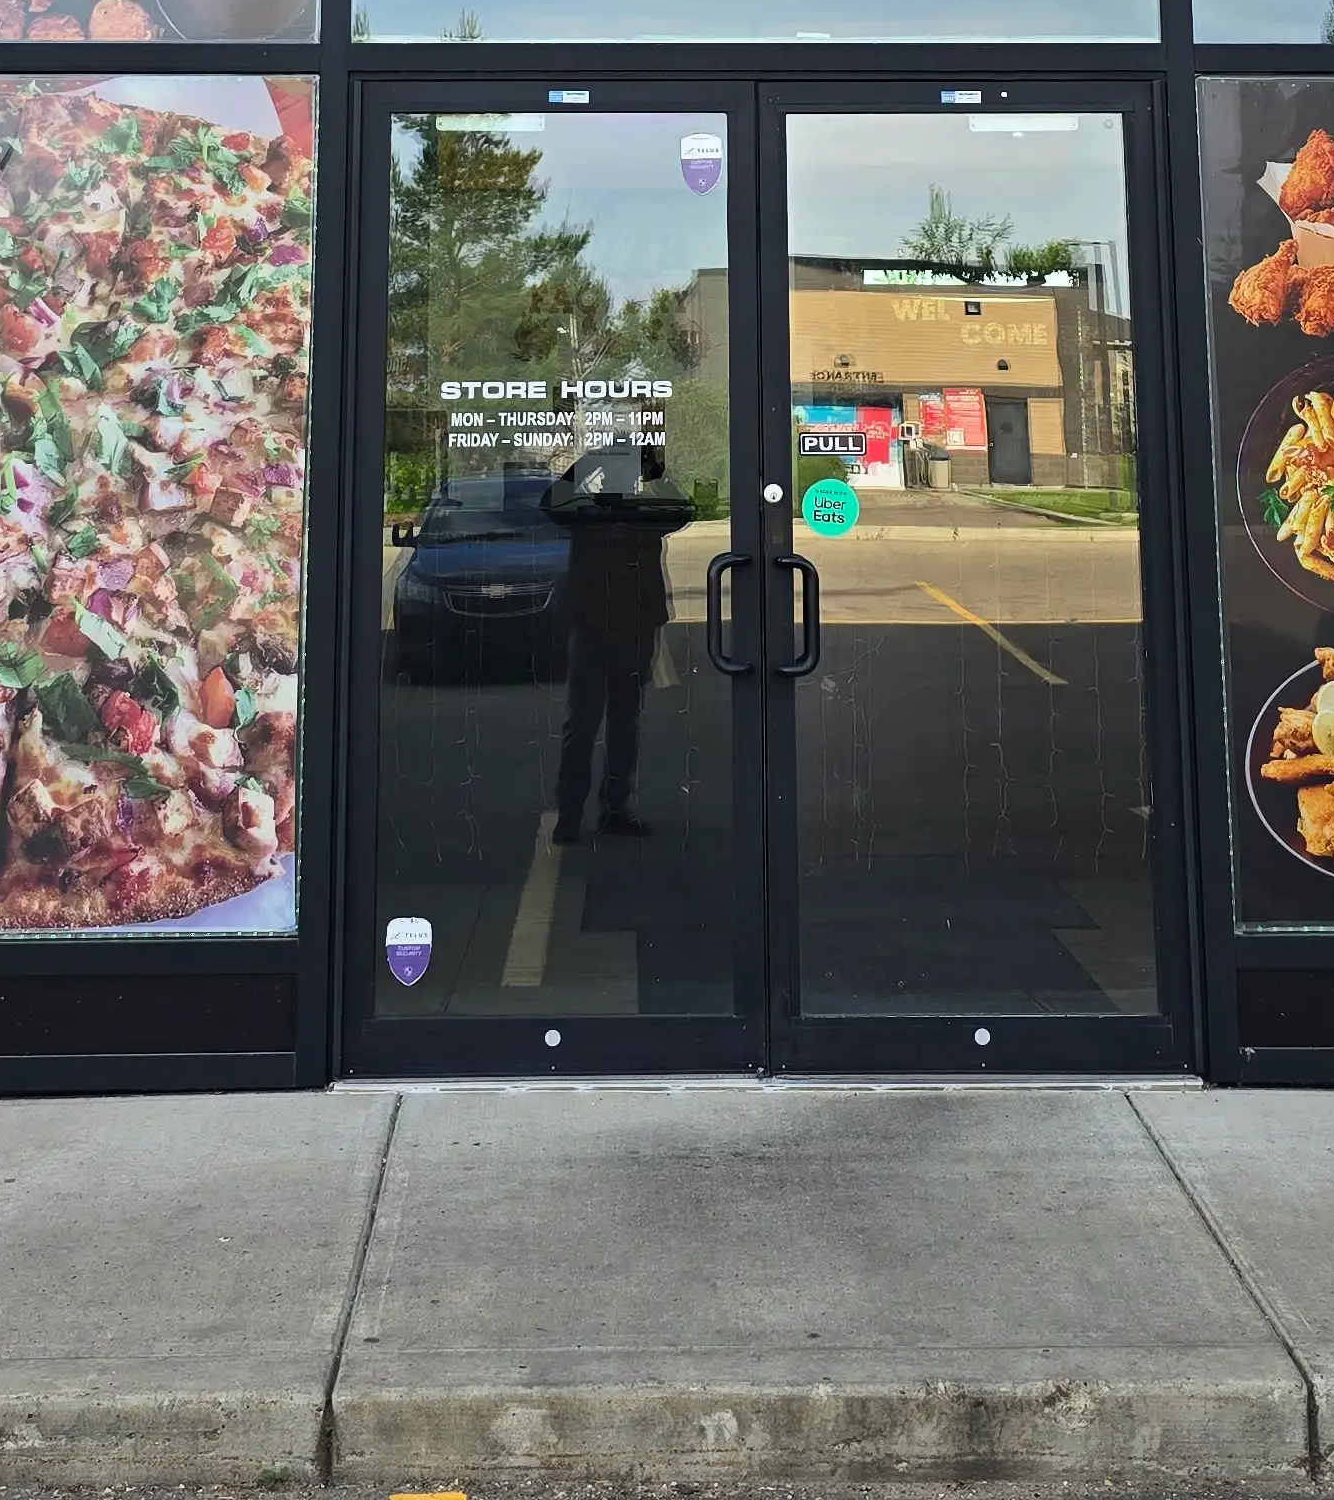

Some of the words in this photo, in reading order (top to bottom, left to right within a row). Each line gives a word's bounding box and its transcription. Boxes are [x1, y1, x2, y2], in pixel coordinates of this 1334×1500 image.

[440, 381, 547, 400] STORE
[561, 380, 673, 398] HOURS
[451, 412, 483, 427] MON
[584, 411, 613, 426] 2PM
[628, 411, 664, 426] 11PM
[448, 432, 499, 448] FRIDAY
[513, 432, 574, 447] SUNDAY:
[585, 431, 614, 446] 2PM
[629, 431, 666, 446] 12AM
[804, 436, 862, 451] PULL
[814, 496, 846, 510] Uber
[813, 510, 845, 524] Eats
